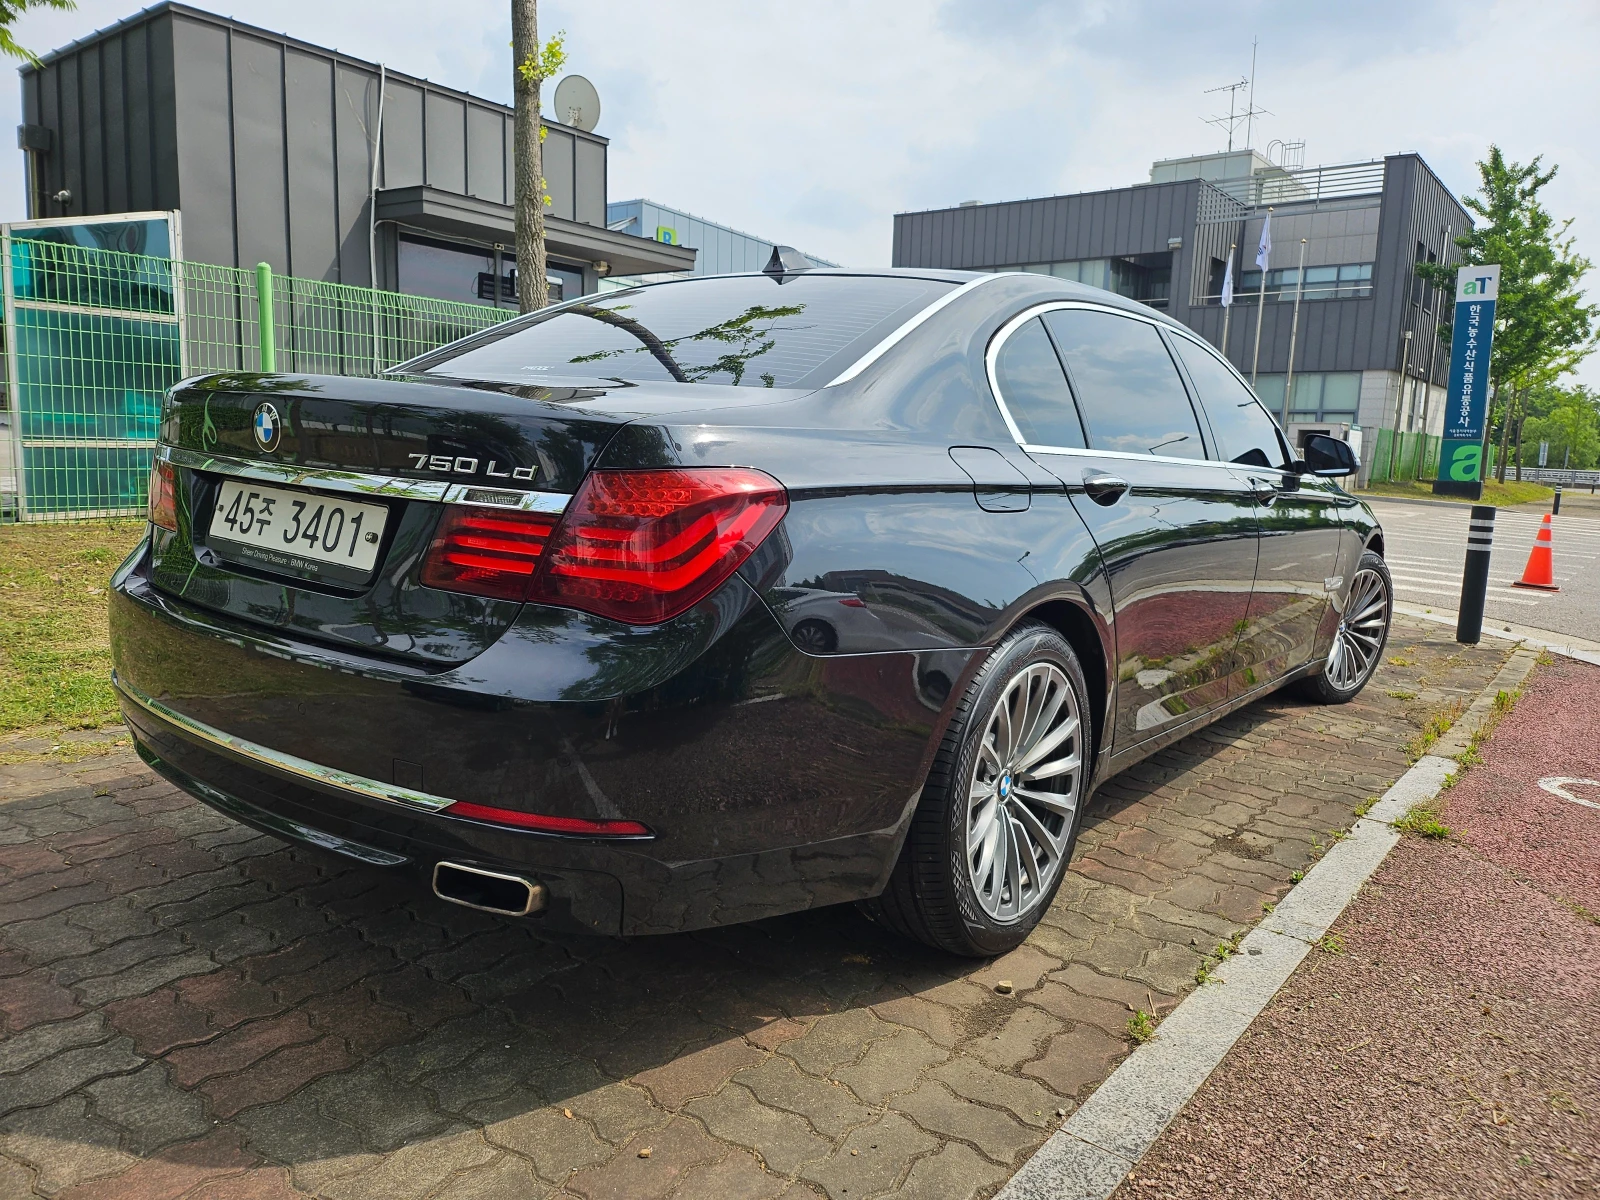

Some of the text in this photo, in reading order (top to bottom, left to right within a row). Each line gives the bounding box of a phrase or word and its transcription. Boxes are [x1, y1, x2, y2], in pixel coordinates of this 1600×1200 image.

[1463, 277, 1492, 295] aT
[1457, 304, 1482, 428] 한국농수산식품유통공사
[408, 453, 539, 482] 750 Ld
[223, 490, 365, 558] 45주 3401
[253, 549, 269, 561] Driving
[268, 553, 288, 565] Pleasure
[290, 558, 304, 569] BMW
[304, 561, 319, 572] Korea
